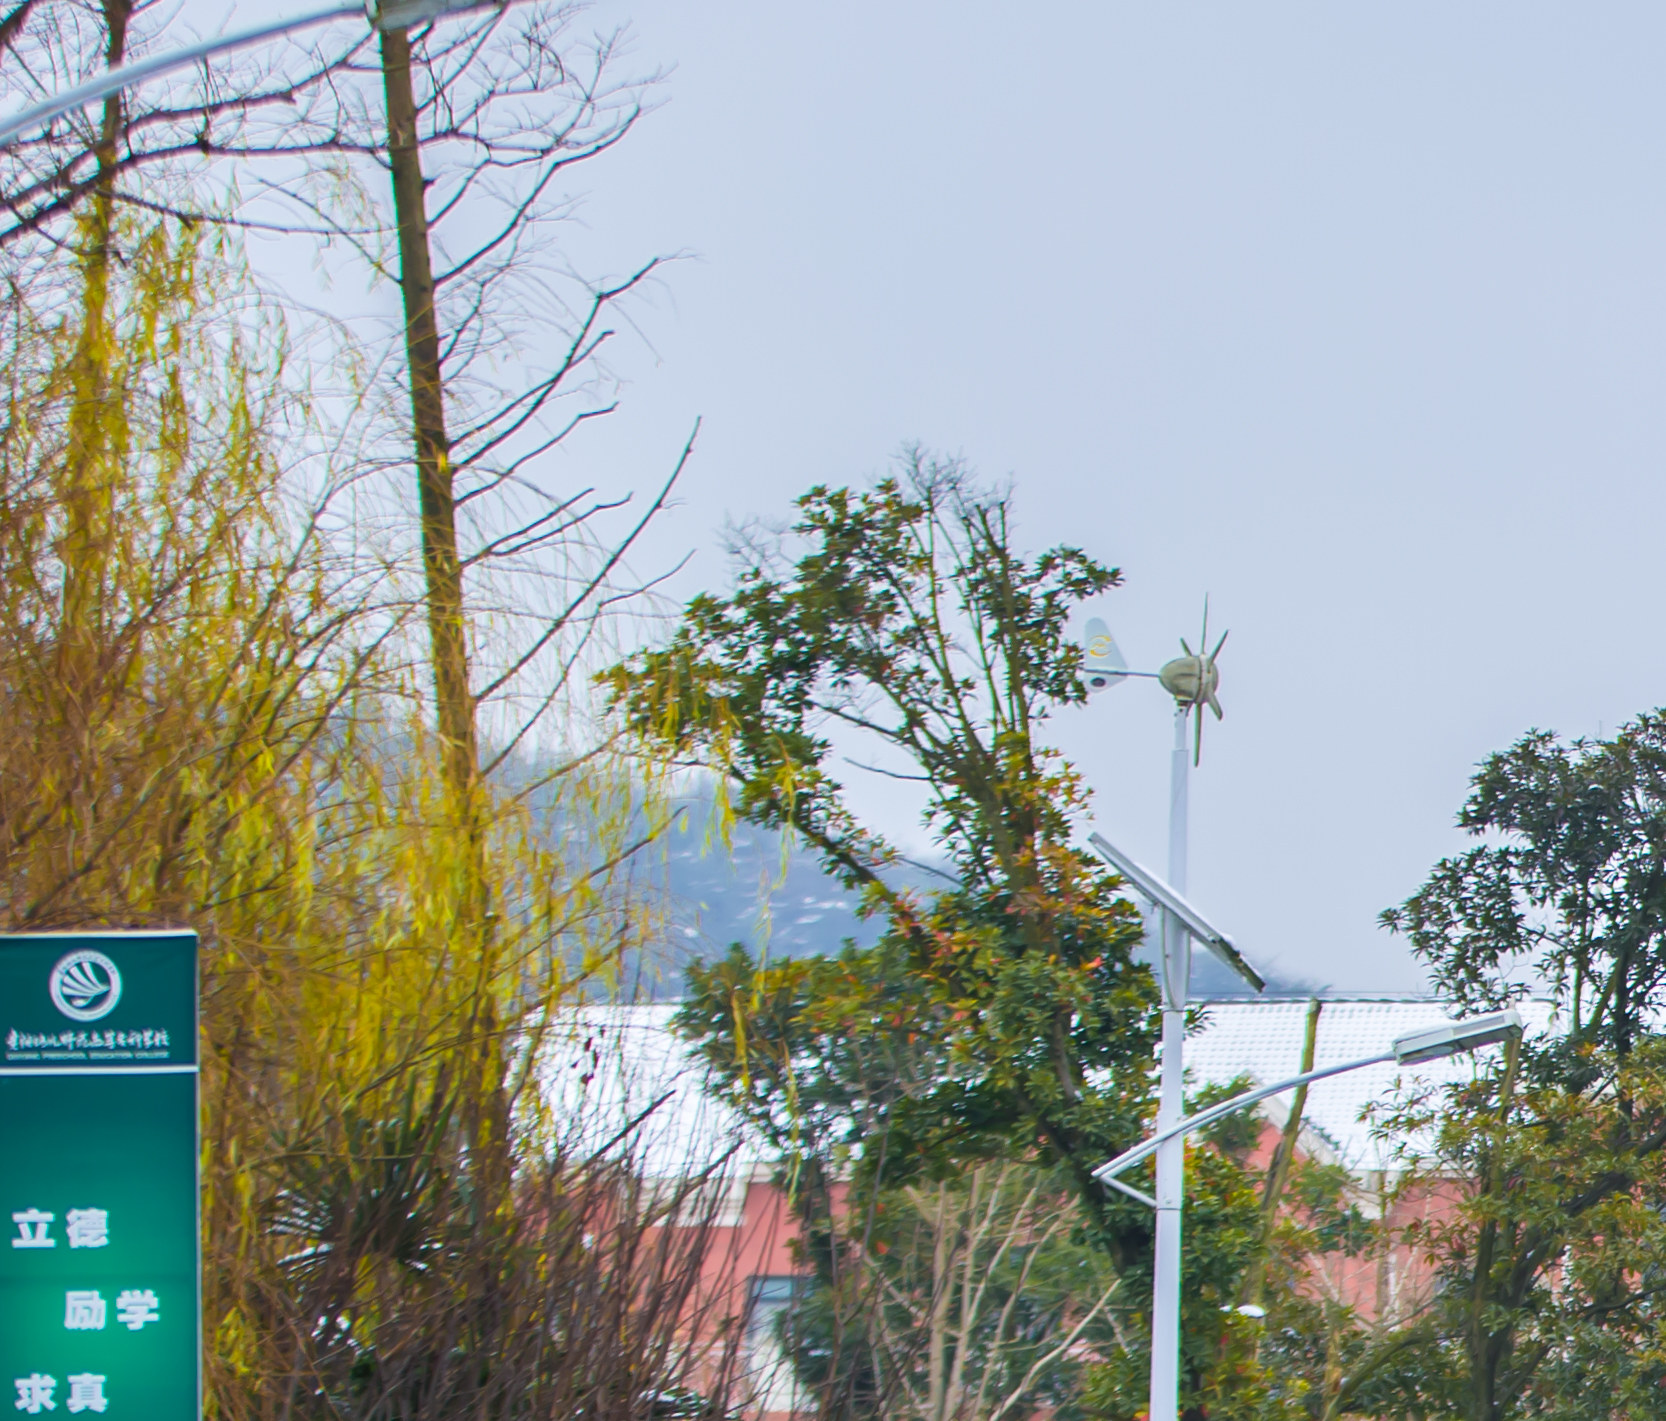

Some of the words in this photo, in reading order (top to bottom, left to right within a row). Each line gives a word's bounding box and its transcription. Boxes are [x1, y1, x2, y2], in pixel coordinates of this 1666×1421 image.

[11, 1207, 109, 1249] 立德
[63, 1289, 160, 1331] 励学
[14, 1372, 109, 1414] 求真
